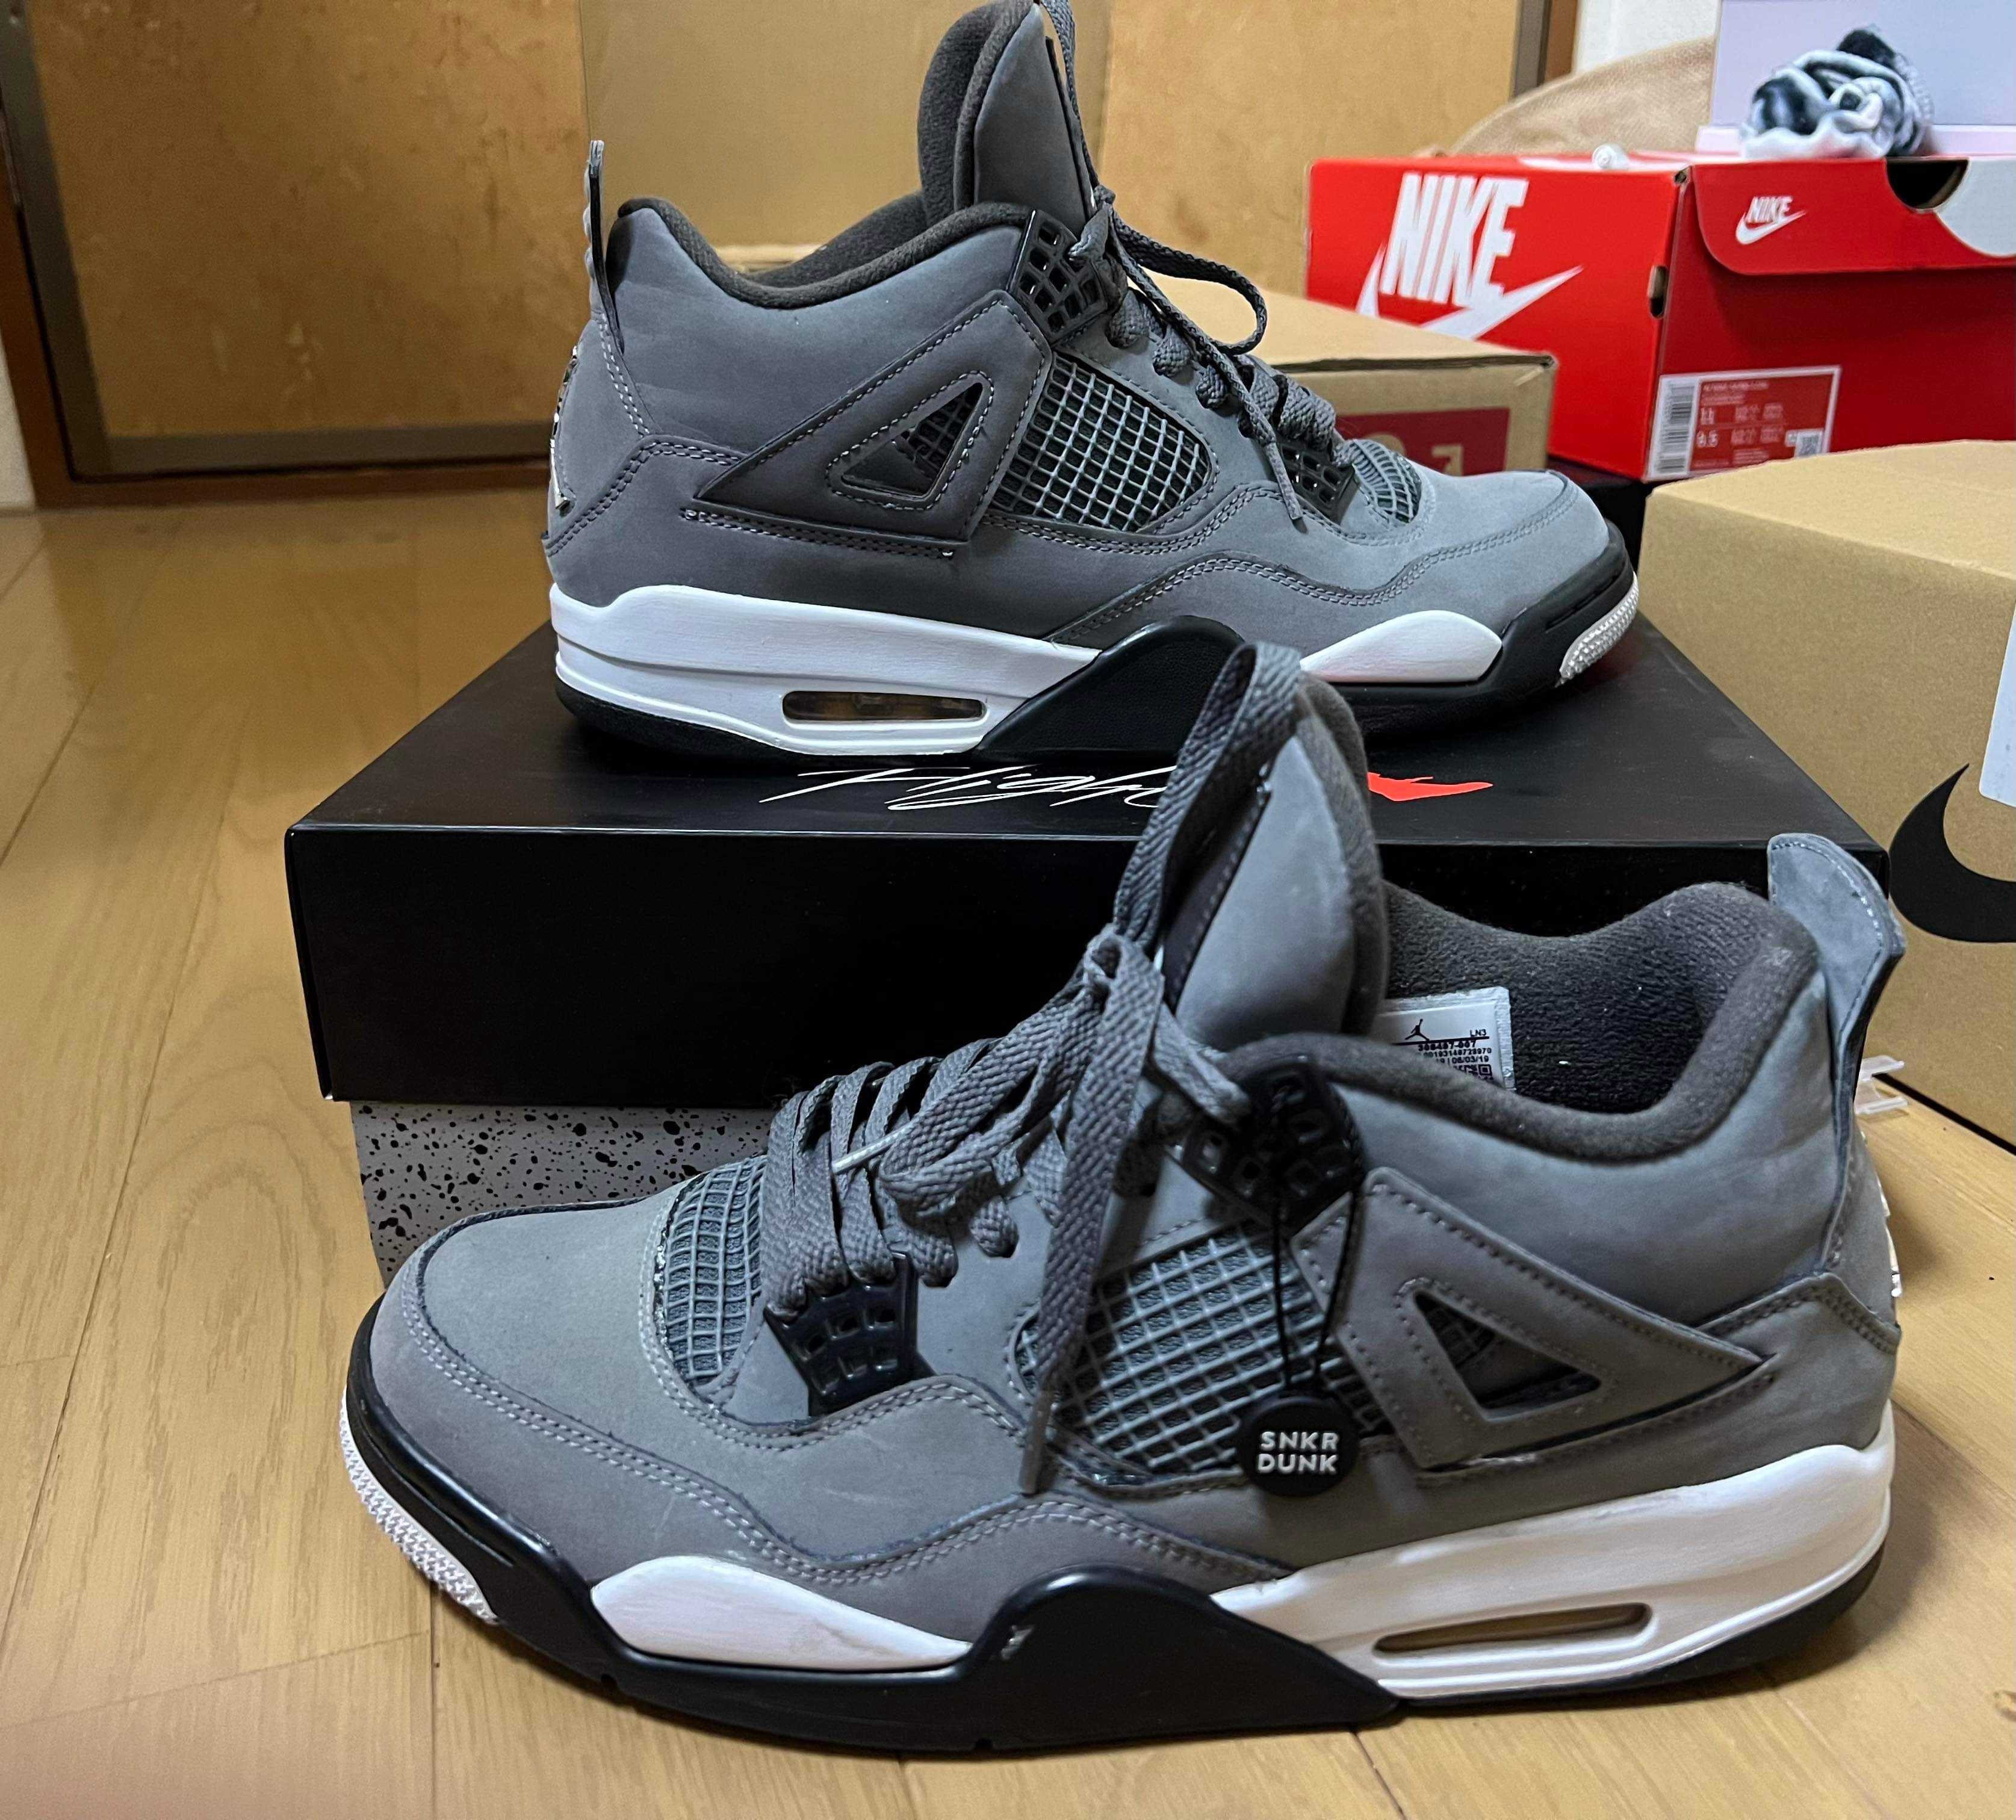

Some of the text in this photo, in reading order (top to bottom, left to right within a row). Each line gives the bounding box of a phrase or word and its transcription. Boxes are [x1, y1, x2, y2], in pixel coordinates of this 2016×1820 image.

[1745, 196, 1793, 224] NIKE
[1380, 172, 1530, 308] NIKE
[1261, 1431, 1339, 1450] SNKR
[1258, 1453, 1338, 1473] DUNK
